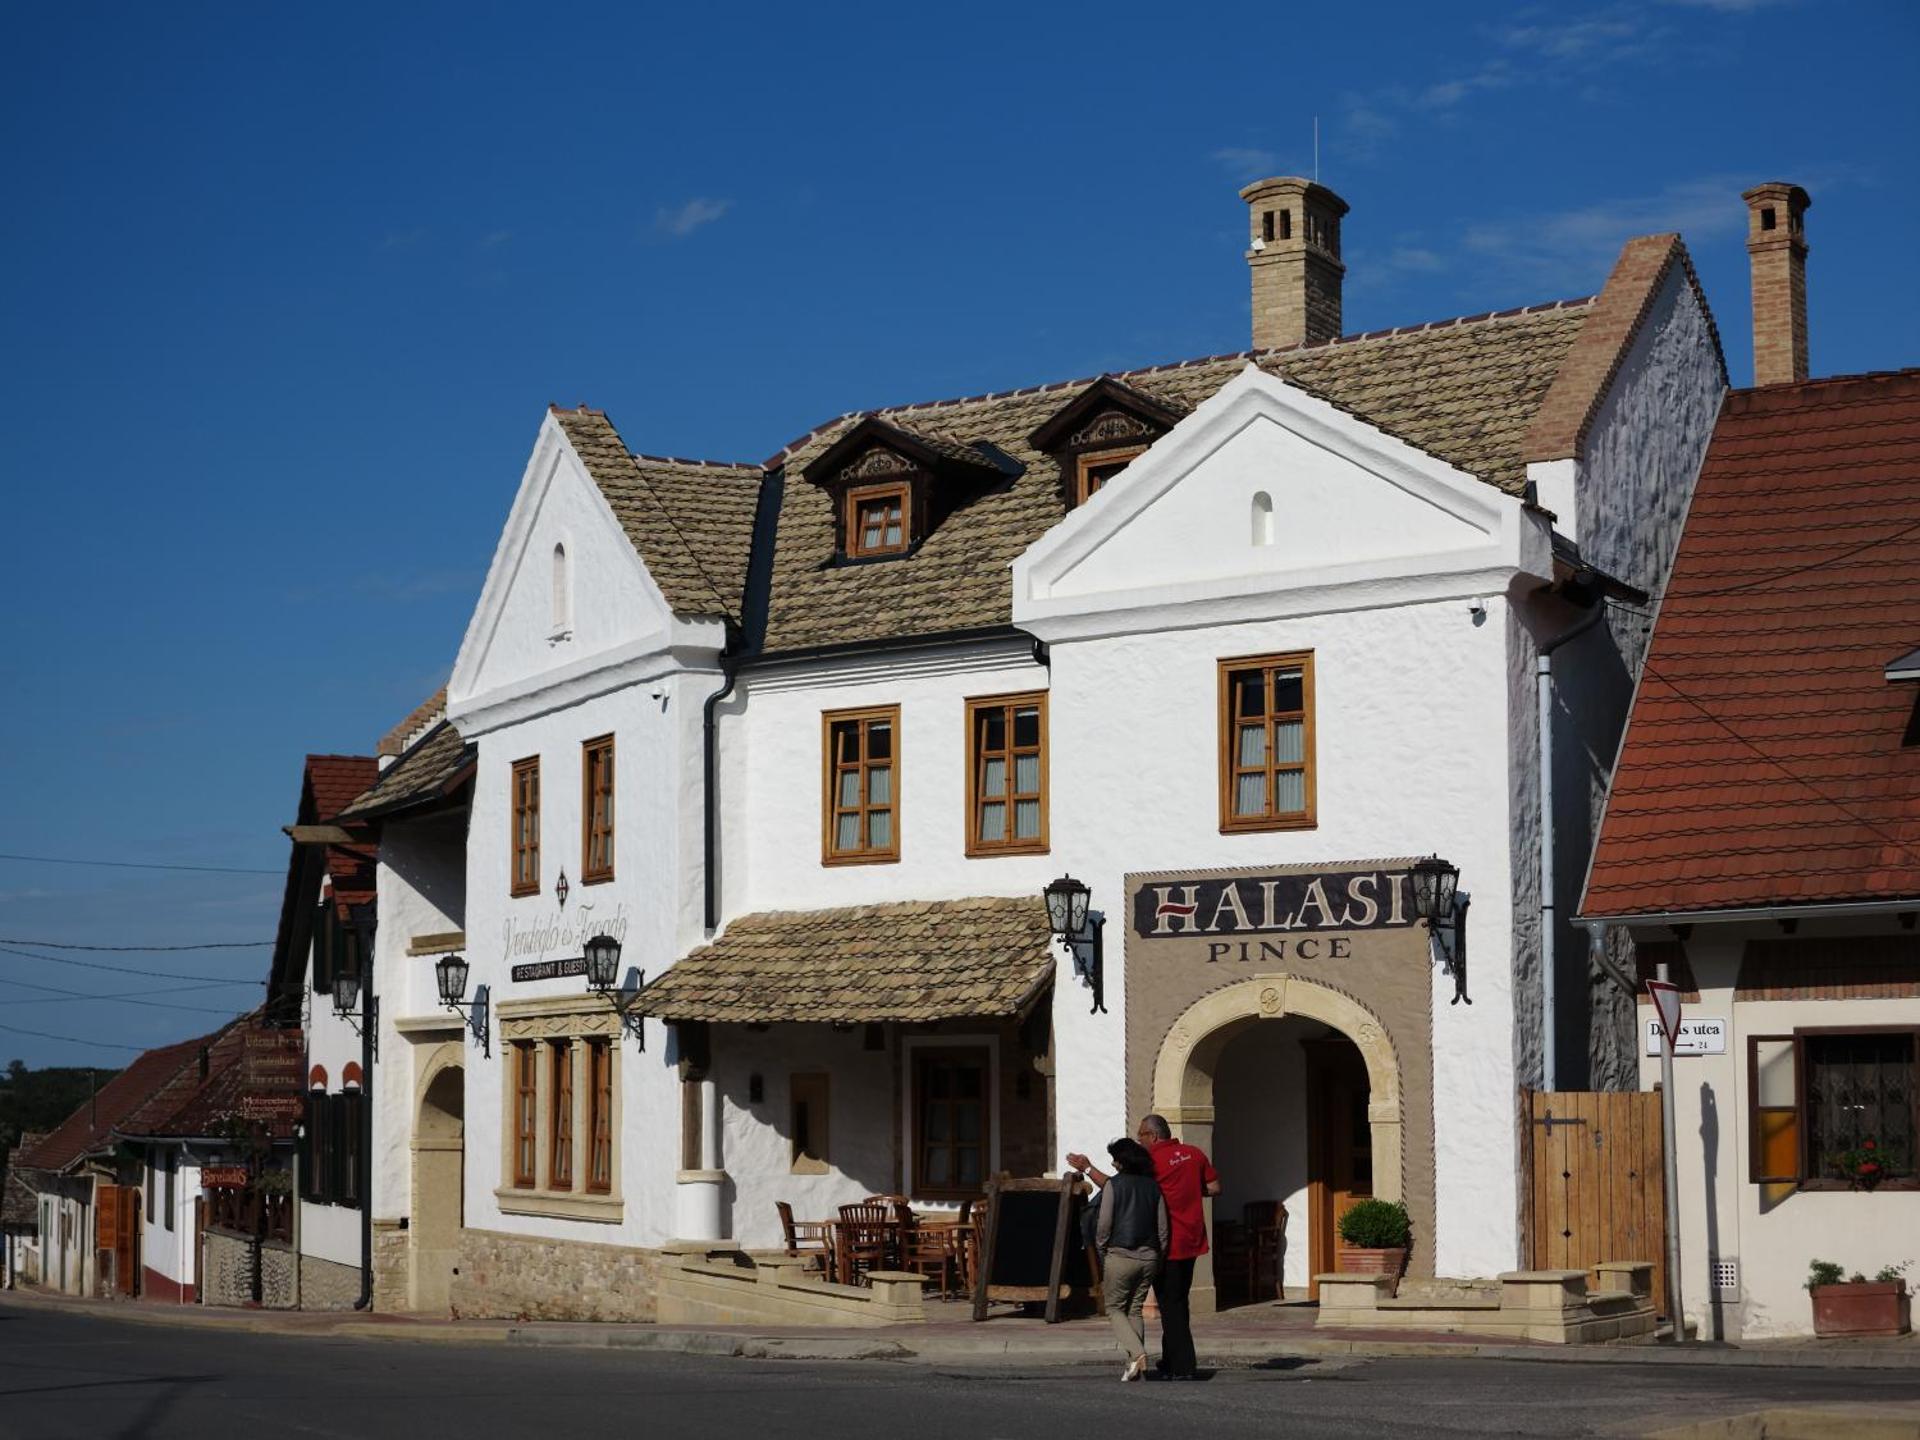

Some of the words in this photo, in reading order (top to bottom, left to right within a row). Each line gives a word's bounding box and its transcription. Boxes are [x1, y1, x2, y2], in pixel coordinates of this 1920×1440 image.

[1150, 874, 1408, 934] HALASI
[1206, 938, 1352, 963] PINCE
[516, 963, 555, 979] RESTAURANT
[1693, 1024, 1719, 1035] utca
